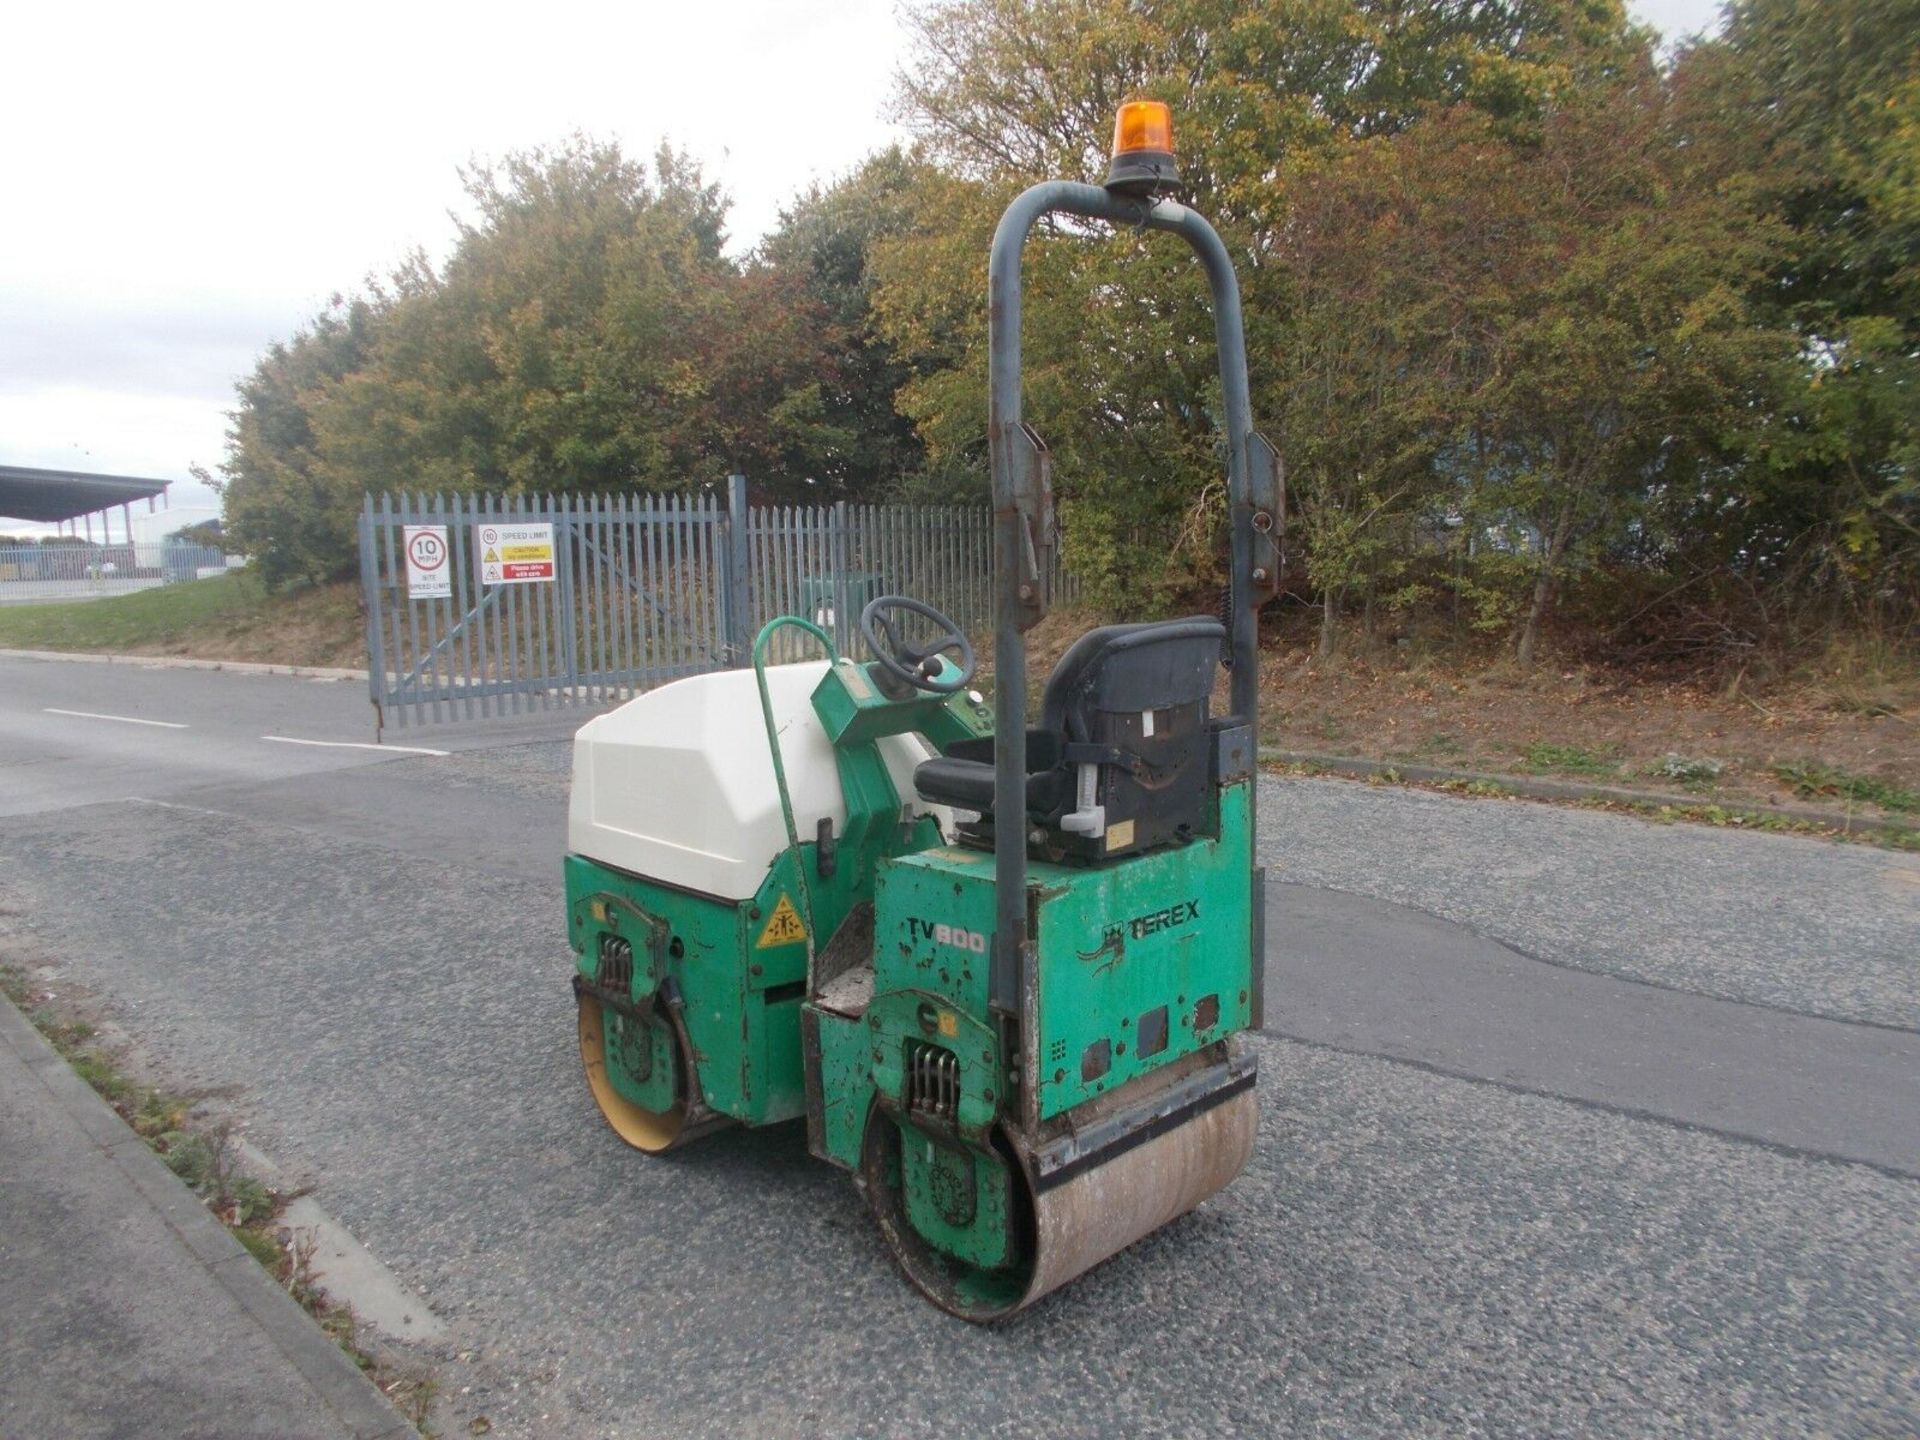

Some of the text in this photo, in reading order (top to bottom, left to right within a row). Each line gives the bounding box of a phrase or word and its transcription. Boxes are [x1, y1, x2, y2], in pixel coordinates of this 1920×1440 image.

[502, 531, 548, 540] SPEED LIMIT
[417, 540, 437, 555] 10
[418, 555, 438, 563] MPH
[411, 582, 450, 591] SPEED LIMIT
[1127, 898, 1200, 940] TEREX
[907, 916, 985, 953] TV800
